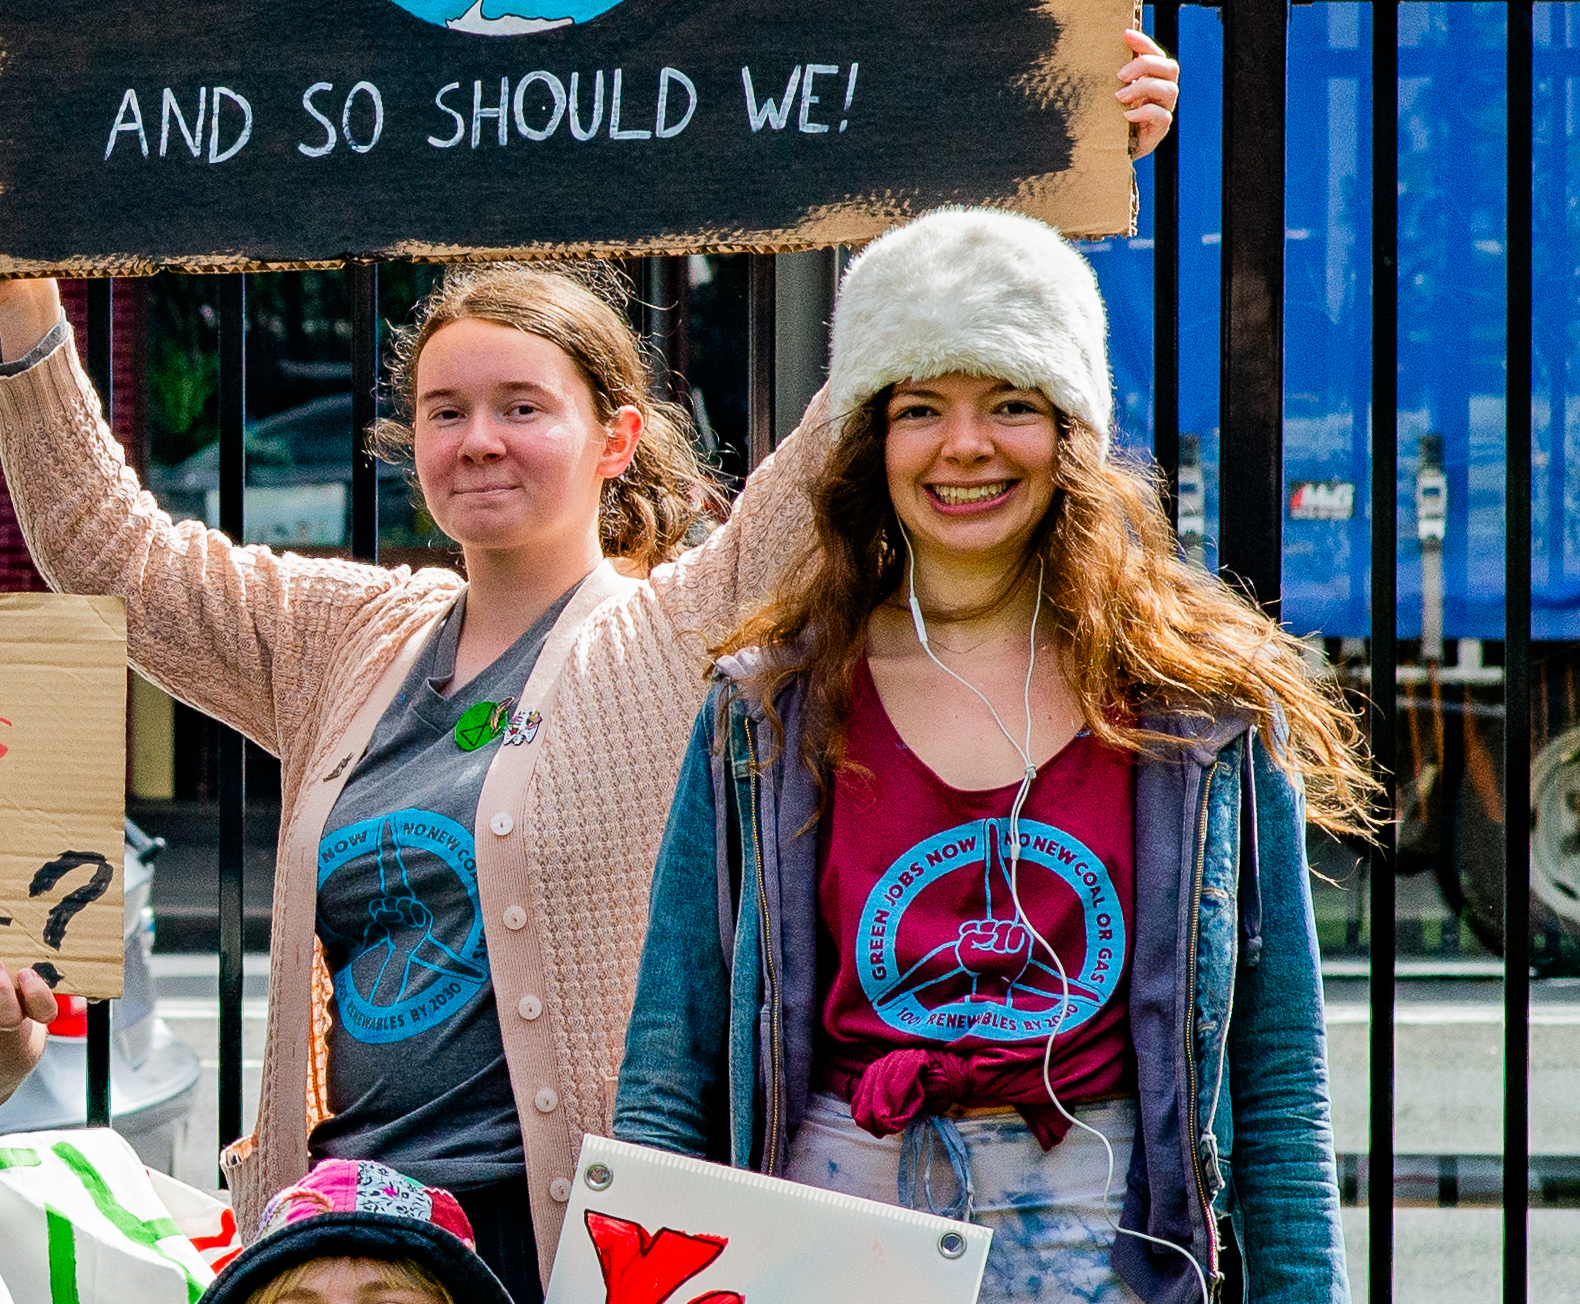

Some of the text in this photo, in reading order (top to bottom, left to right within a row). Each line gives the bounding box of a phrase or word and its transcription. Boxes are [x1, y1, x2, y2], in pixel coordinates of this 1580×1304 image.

[103, 61, 861, 164] AND SO SHOULD WE!
[320, 830, 368, 864] NOW
[404, 822, 427, 837] NO
[426, 826, 461, 851] NEW
[868, 836, 977, 980] GREEN JOBS NOW
[1003, 832, 1113, 984] NO NEW COAL OR GAS
[409, 1004, 428, 1023] BY
[428, 982, 462, 1013] 2030
[1023, 1018, 1041, 1030] BY
